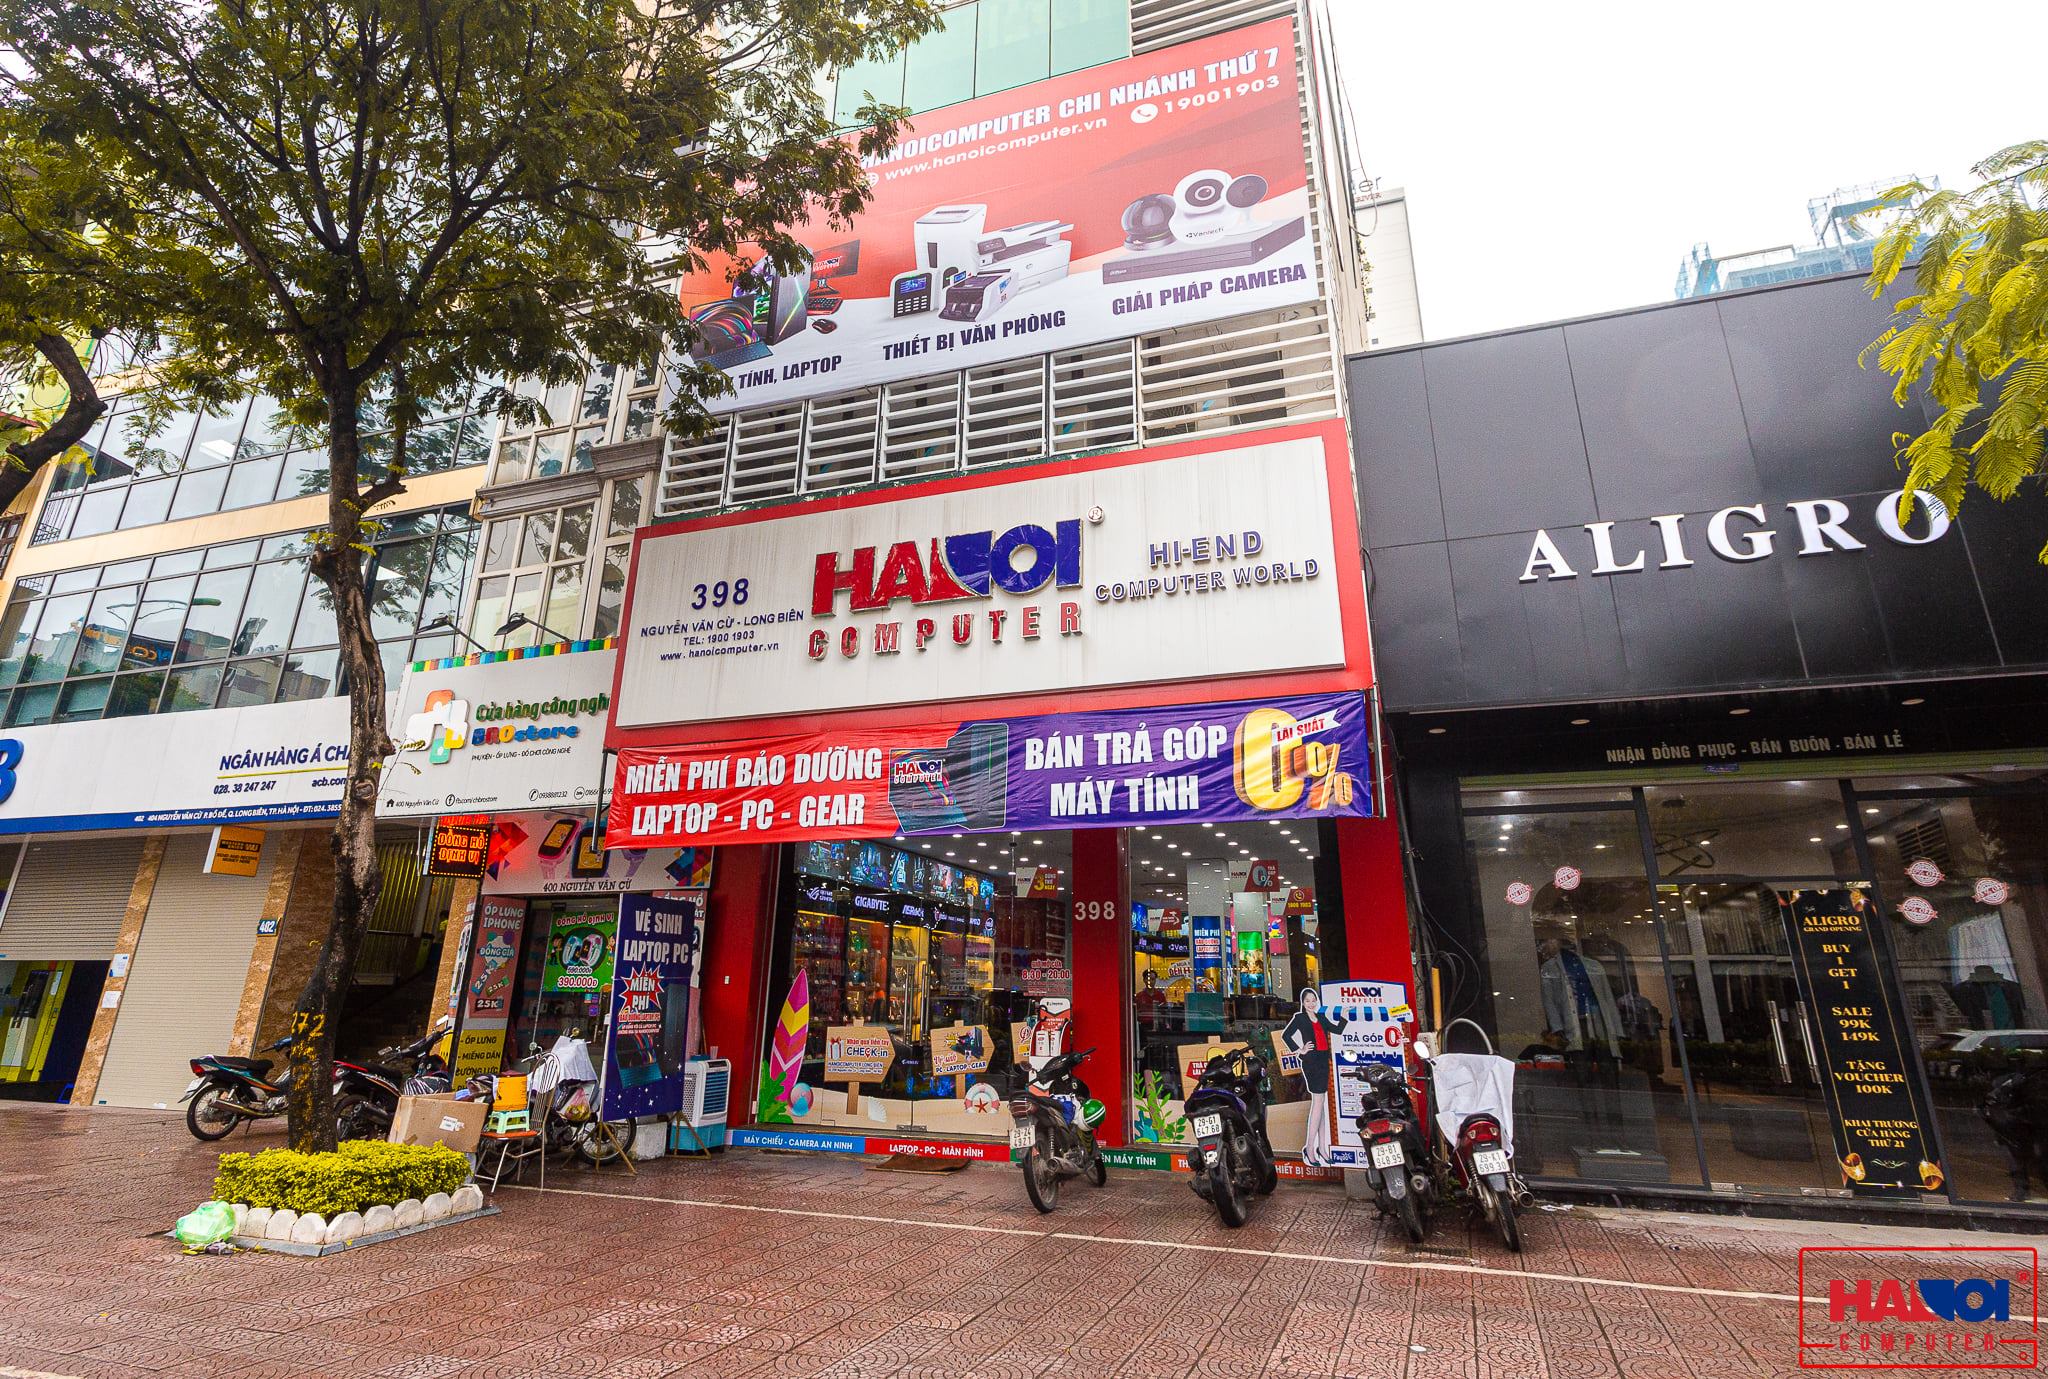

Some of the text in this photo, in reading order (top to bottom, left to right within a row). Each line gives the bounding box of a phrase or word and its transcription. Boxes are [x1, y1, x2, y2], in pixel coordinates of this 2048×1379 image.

[1059, 92, 1101, 118] CHI
[1110, 69, 1196, 107] NHÁNH
[1204, 49, 1258, 83] THỨ
[1264, 47, 1279, 68] 7
[1164, 75, 1280, 113] 19001903
[885, 117, 1107, 181] www.hanoicomputer.vn
[1112, 263, 1307, 315] GIẢI PHÁP CAMERA
[883, 310, 1065, 360] THIẾT BỊ VĂN PHÒNG
[783, 355, 841, 380] LAPTOP
[1519, 489, 1952, 583] ALIGRO
[1149, 530, 1263, 567] HI-END
[1095, 558, 1320, 601] COMPUTER WORLD
[691, 578, 749, 610] 398
[640, 609, 805, 637] NGUYỄN VĂN CỪ LONG BIÊN
[683, 631, 755, 646] TEL: 1900 1903
[808, 602, 1083, 660] COMPUTER
[541, 697, 577, 718] công
[1025, 721, 1228, 771] BÁN TRẢ GÓP
[1606, 730, 1903, 763] NHẬN ĐỒNG PHỤC BÁN BUÔN BÁN LẺ
[219, 743, 322, 770] NGÂN HÀNG Á
[625, 746, 883, 794] MIỄN PHÍ BẢO DƯỠNG
[894, 774, 943, 784] COMPUTER
[213, 780, 277, 794] 028. 38 247 247
[1050, 772, 1199, 817] MÁY TÍNH
[631, 794, 865, 836] LAPTOP PC GEAR
[543, 883, 558, 892] 400
[484, 901, 498, 916] ỐP
[855, 895, 888, 910] GIGABYTE
[1075, 901, 1115, 920] 398
[259, 920, 276, 932] 402
[483, 917, 521, 930] IPHONE
[635, 908, 682, 936] VỆ SINH
[1803, 916, 1860, 926] ALIGRO
[623, 939, 689, 965] LAPTOP, PC
[1822, 944, 1851, 953] BUY
[1837, 956, 1844, 965] 1
[1828, 968, 1857, 977] GET
[630, 969, 655, 992] MIỄN
[1843, 981, 1850, 989] 1
[477, 1000, 498, 1008] 25K
[1831, 1007, 1873, 1016] SALE
[291, 1011, 325, 1038] 172
[1839, 1019, 1871, 1029] 99K
[465, 1034, 476, 1044] ỐP
[1343, 1032, 1383, 1042] TRẢ GÓP
[1841, 1032, 1880, 1041] 149K
[946, 1065, 967, 1073] LAPTOP
[971, 1062, 987, 1070] GEAR
[1834, 1072, 1905, 1082] VOUCHER
[1856, 1085, 1893, 1094] 100K
[1844, 1119, 1871, 1127] KHAI
[743, 1133, 853, 1150] MÁY CHIẾU CAMERA AN NINH
[889, 1143, 983, 1157] LAPTOP PC MÀN HÌNH
[1113, 1151, 1133, 1164] MÁY
[1136, 1153, 1157, 1166] TÍNH
[1296, 1166, 1304, 1178] BỊ
